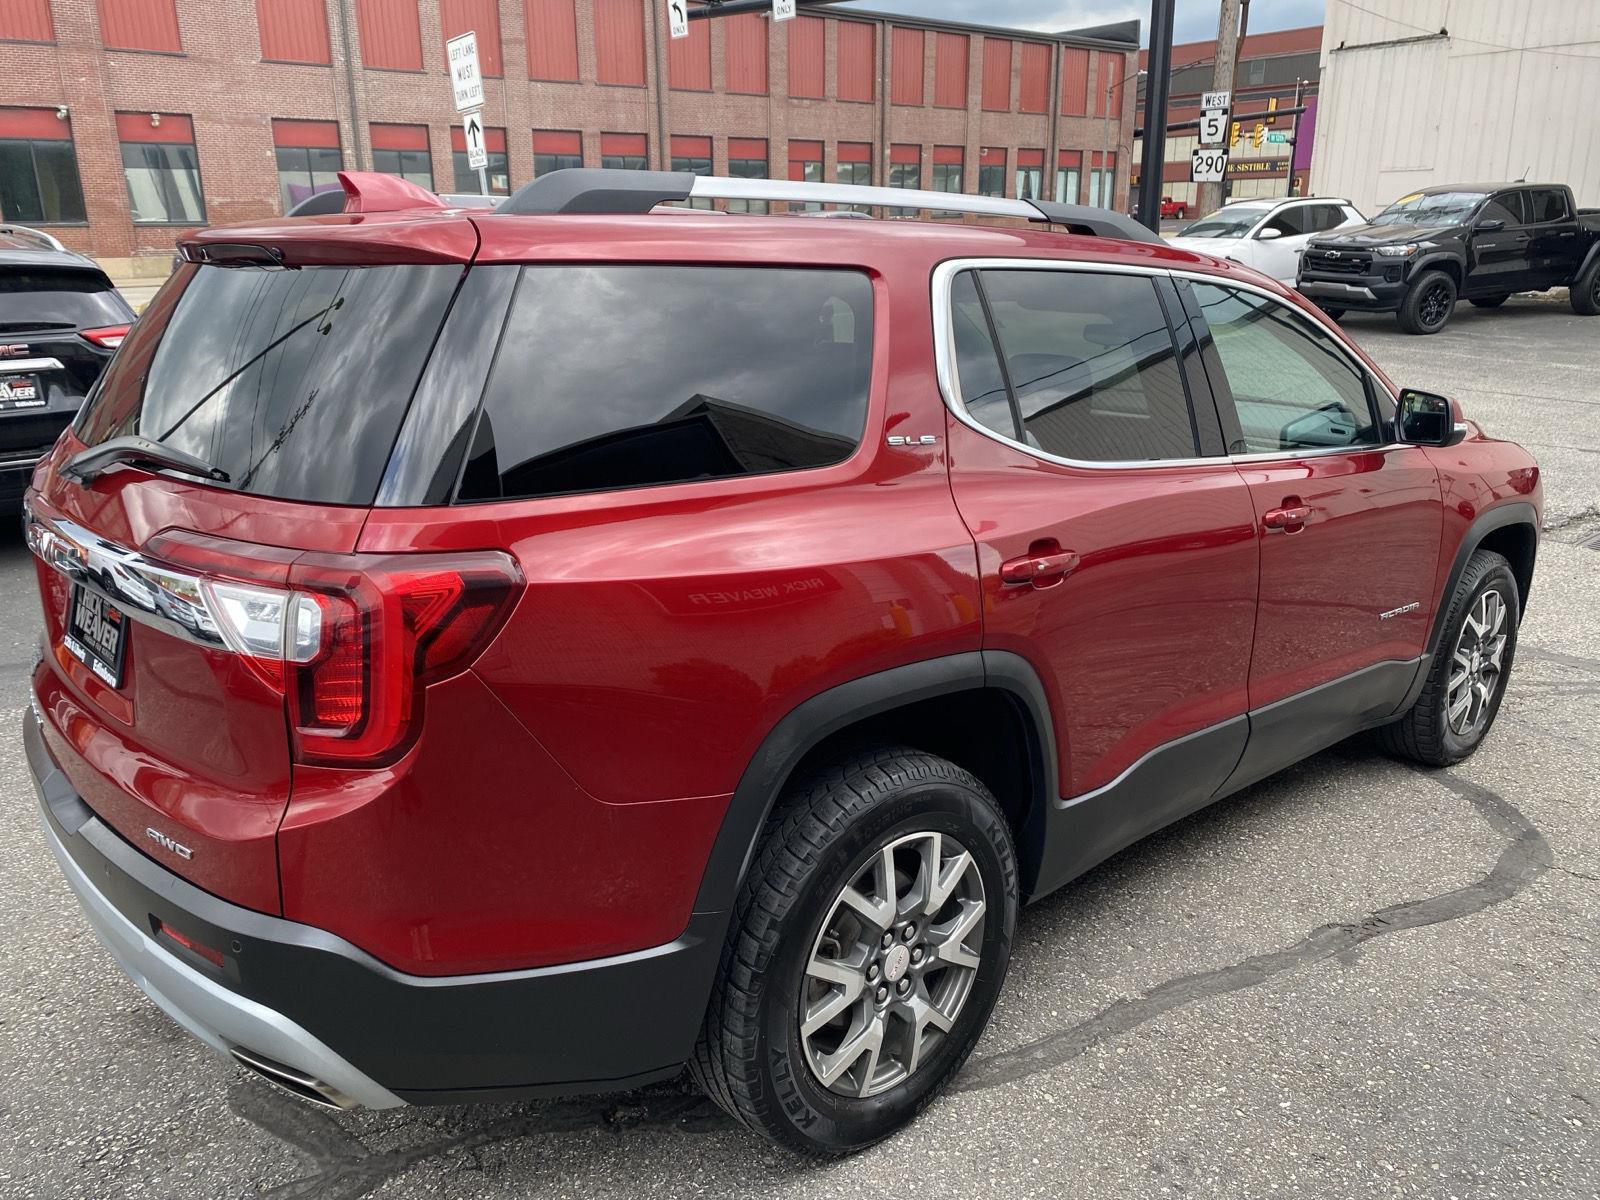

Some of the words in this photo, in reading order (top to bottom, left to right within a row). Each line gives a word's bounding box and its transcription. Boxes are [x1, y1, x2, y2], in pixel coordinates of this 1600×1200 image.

[777, 4, 792, 15] ONLY
[673, 25, 685, 35] ONLY
[450, 48, 461, 61] LEFT
[462, 42, 474, 56] LANE
[457, 64, 473, 80] MUST
[456, 89, 468, 101] TURN
[469, 85, 480, 98] LEFT
[1205, 95, 1227, 107] WEST
[1206, 118, 1219, 136] 5
[1195, 156, 1224, 174] 290
[887, 435, 937, 447] SLE
[1379, 601, 1420, 621] ACADIA
[75, 601, 119, 655] WEAVER
[145, 827, 194, 860] AWD
[771, 1047, 818, 1130] KELLY
